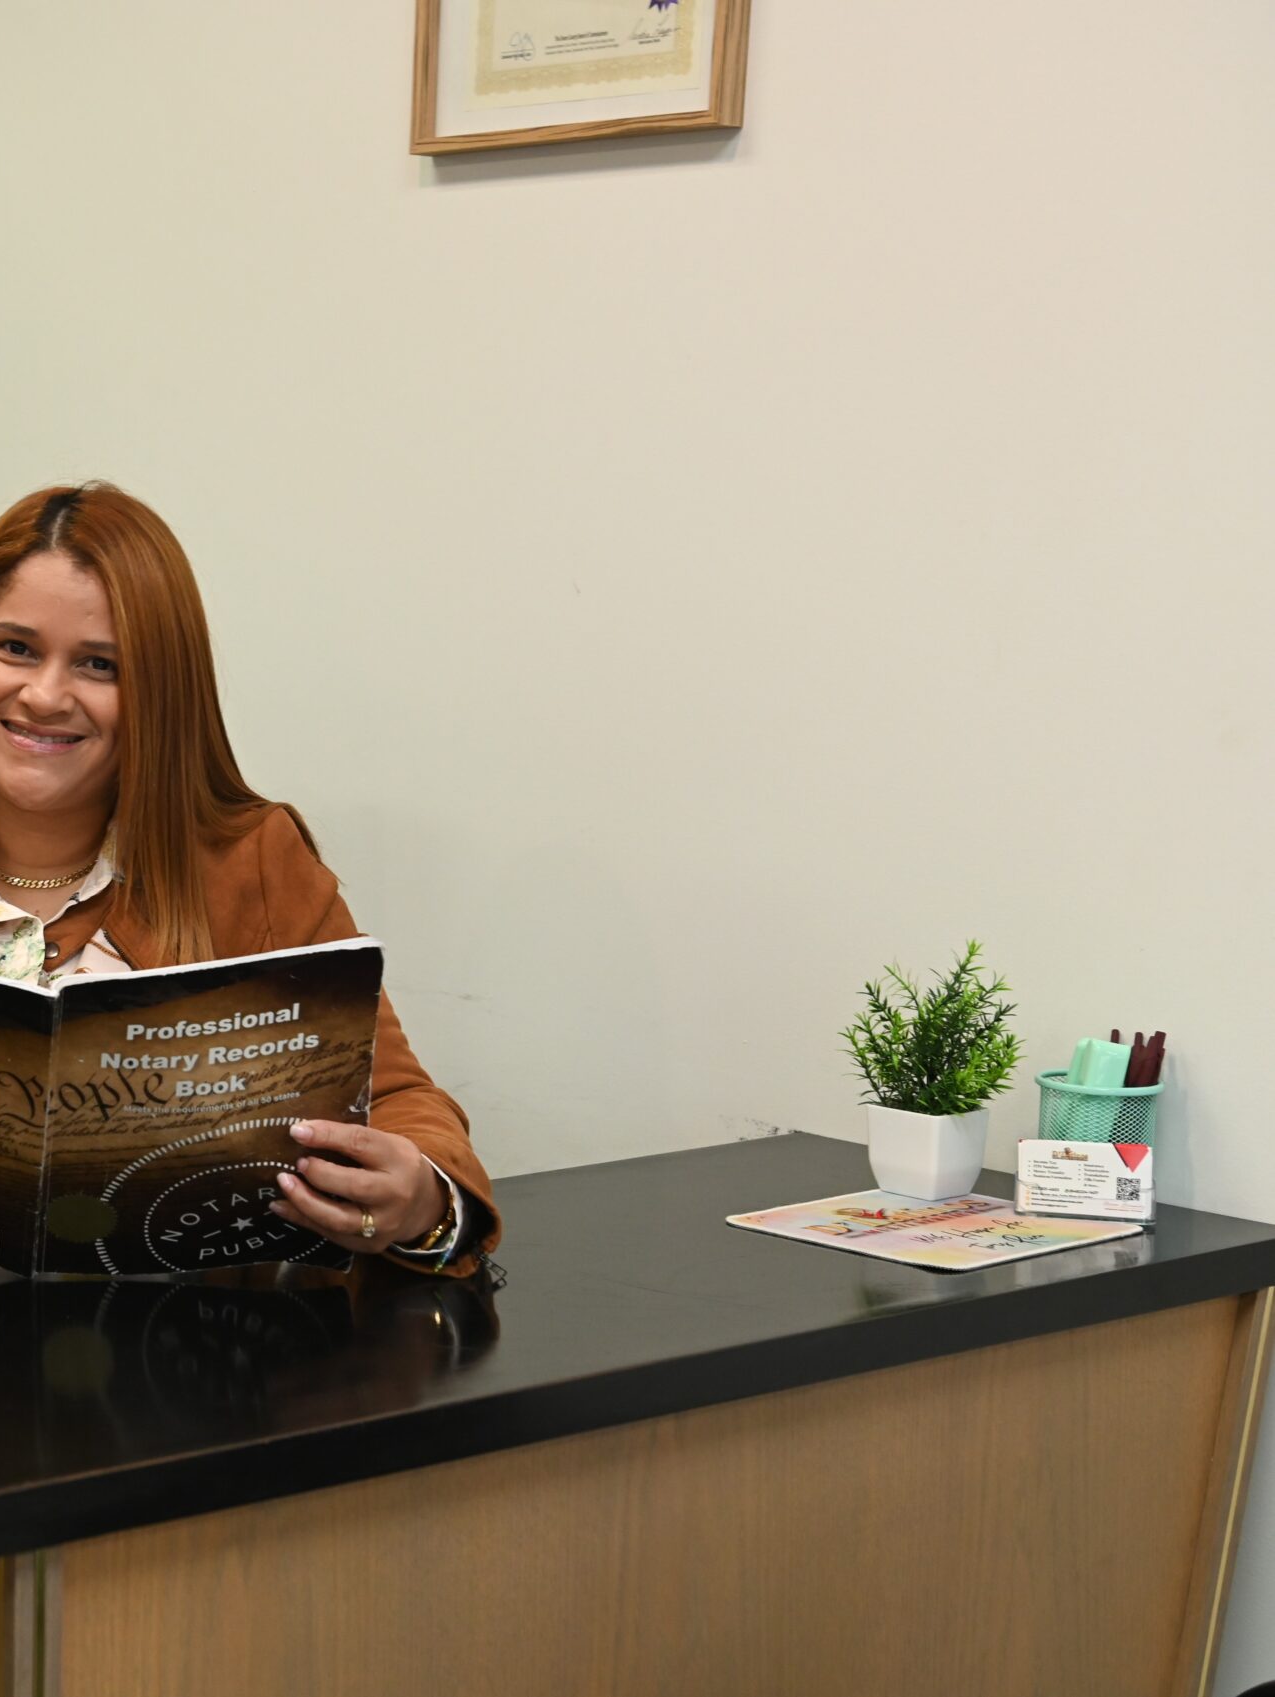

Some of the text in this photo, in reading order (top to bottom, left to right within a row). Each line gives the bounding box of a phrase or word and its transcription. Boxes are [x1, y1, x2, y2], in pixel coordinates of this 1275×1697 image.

[126, 1003, 300, 1041] Professional
[100, 1033, 320, 1072] Notary Records
[124, 1091, 301, 1114] Meets the requirements of all 50 states
[175, 1074, 246, 1098] Book
[159, 1187, 276, 1242] NOTAR
[199, 1223, 297, 1260] PUBLI
